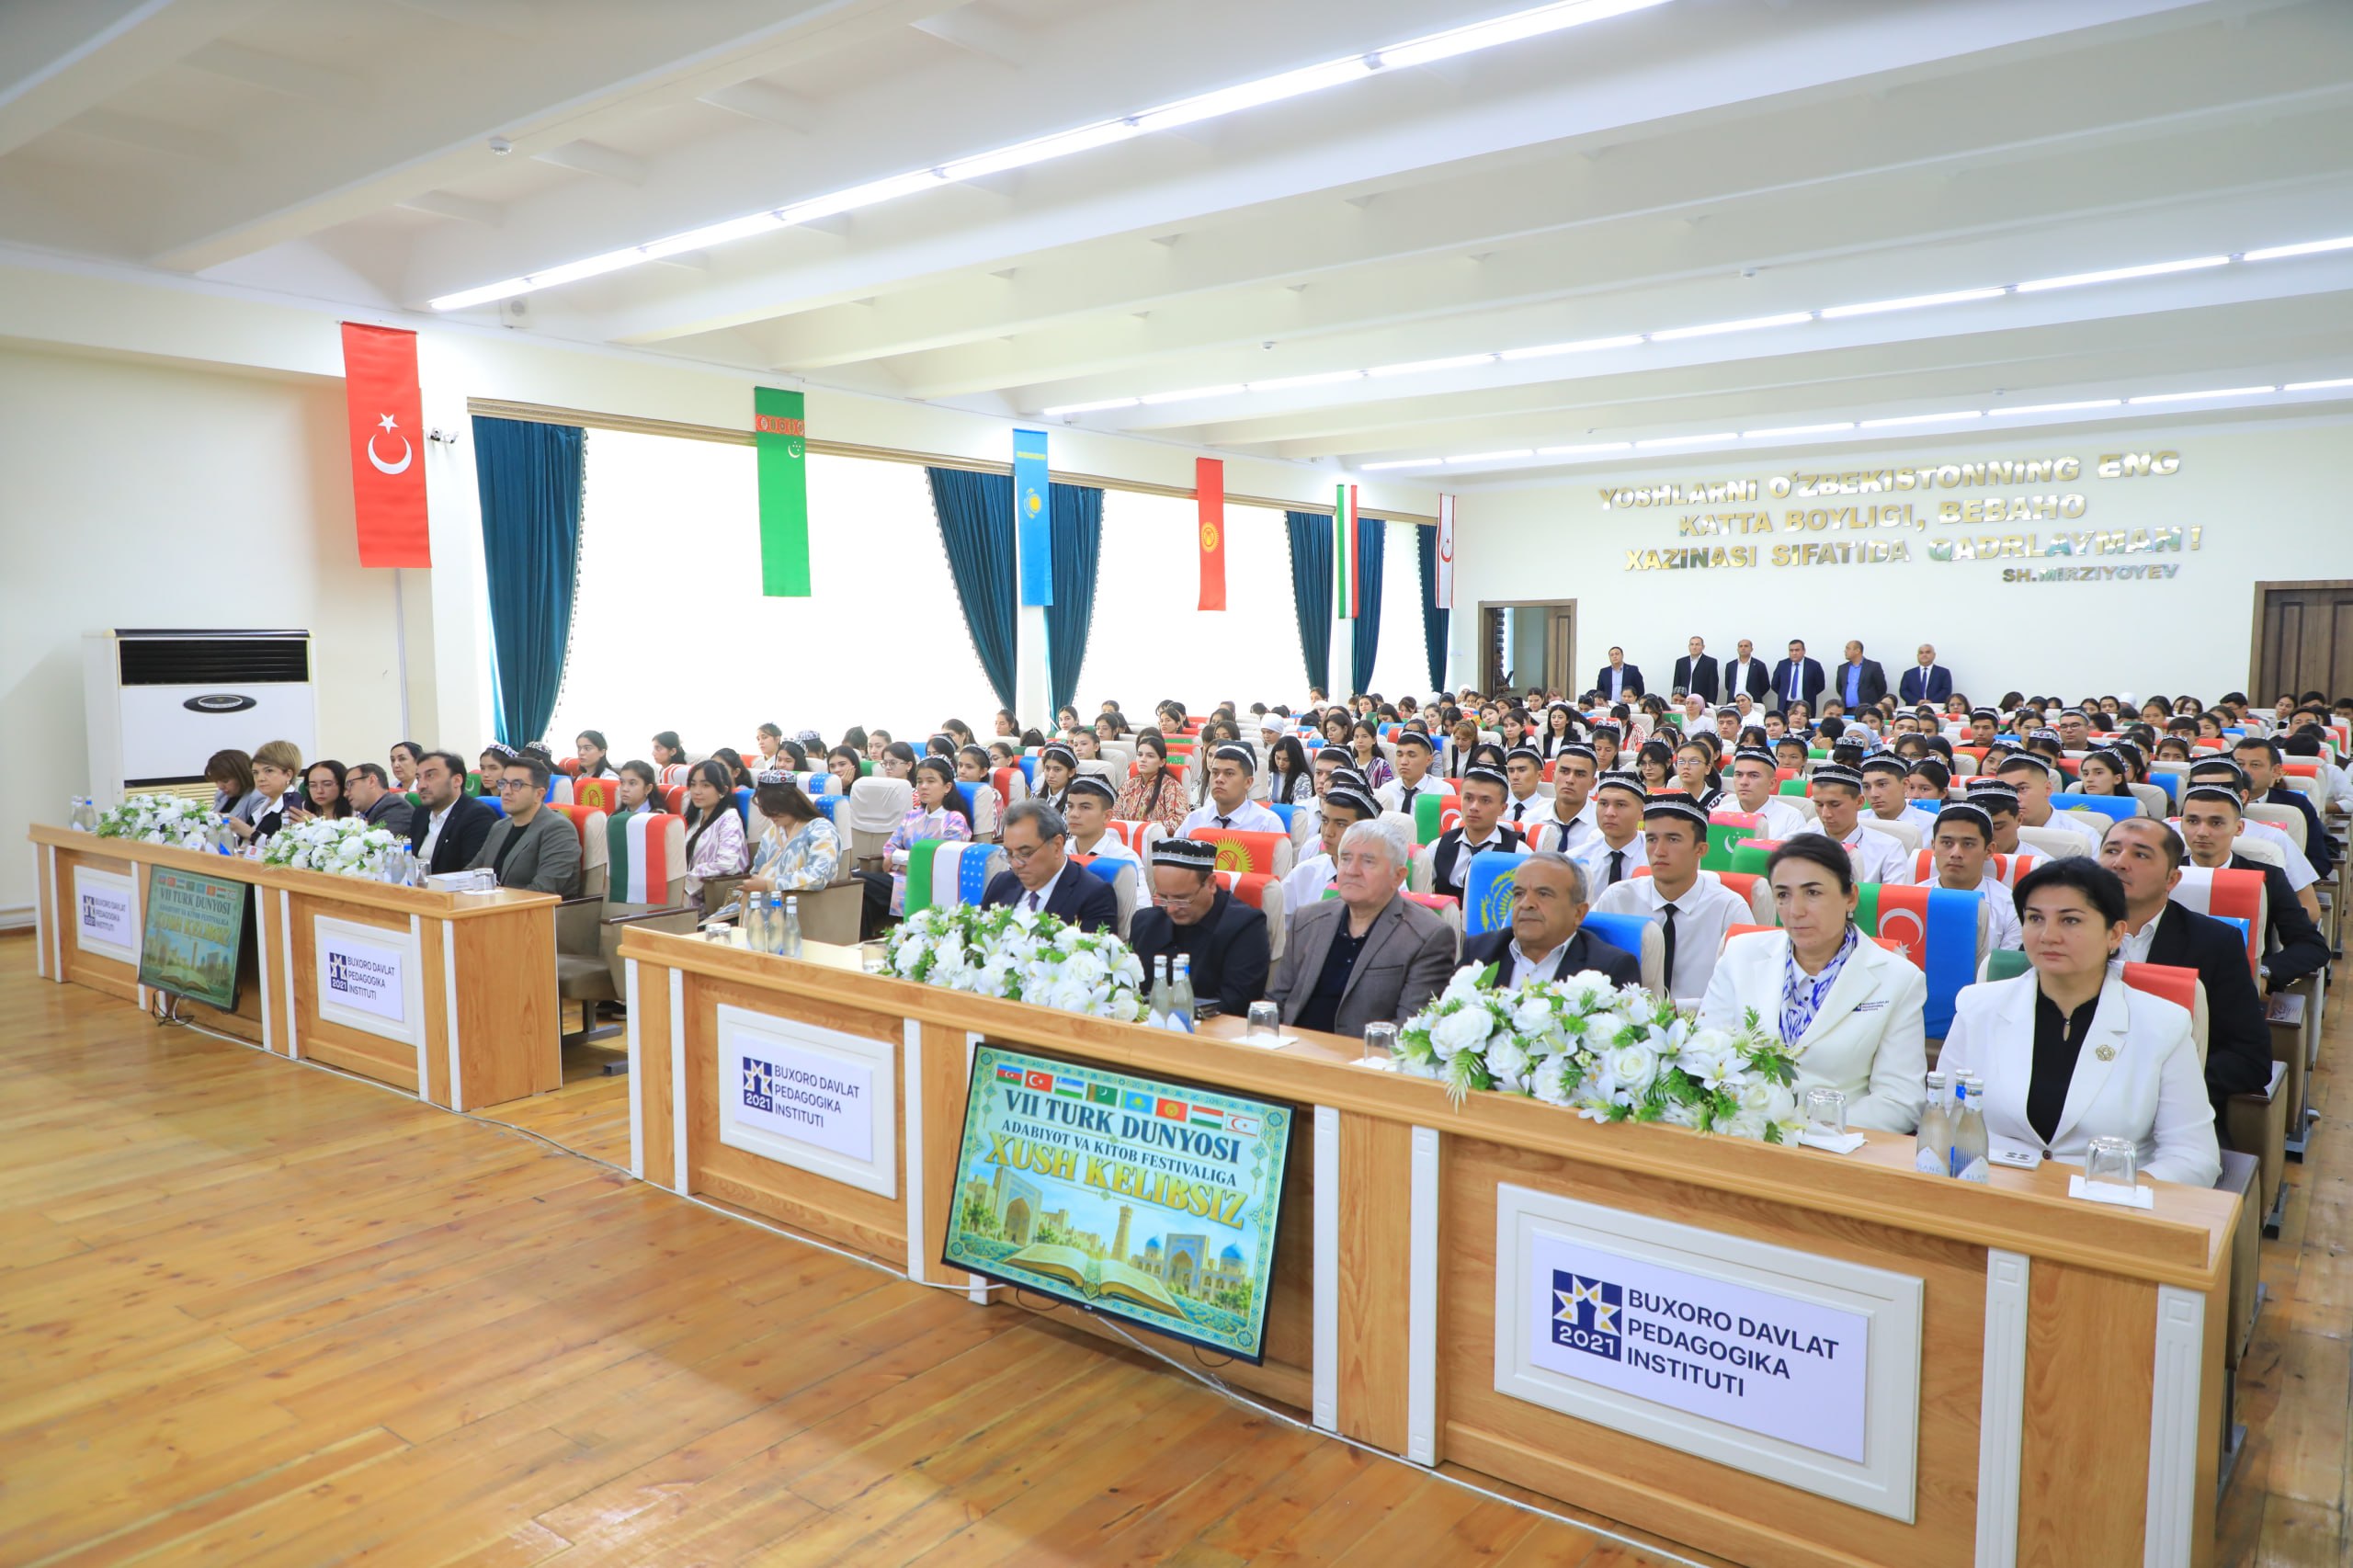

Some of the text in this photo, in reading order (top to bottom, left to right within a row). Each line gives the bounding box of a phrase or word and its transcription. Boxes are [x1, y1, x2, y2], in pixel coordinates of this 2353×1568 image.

[1598, 478, 1758, 510] YOSHLARNI
[2097, 449, 2181, 479] ENG
[1678, 493, 2087, 538] KATTA BOYLIGI, BEBAHO
[1623, 544, 1757, 571] XAZINASI
[1770, 539, 1913, 567] SIFATIDA
[173, 891, 194, 907] TURK
[195, 895, 232, 916] DUNYOSI
[347, 957, 395, 977] BUXORO DAVLAT
[347, 970, 386, 988] PEDAGOGIKA
[332, 978, 347, 992] 2021
[348, 984, 377, 1000] INSTITUTI
[774, 1064, 860, 1099] BUXORO DAVLAT
[745, 1092, 771, 1110] 2021
[774, 1084, 842, 1114] PEDAGOGIKA
[775, 1103, 824, 1128] INSTITUTI
[1005, 1088, 1243, 1165] VII TURK DUNYOSI
[1001, 1119, 1237, 1187] ADABIYOT VA KITOB FESTIVALIGA
[984, 1131, 1249, 1231] XUSH KELIBSIZ
[1559, 1324, 1616, 1357] 2021
[1628, 1288, 1839, 1360] BUXORO DAVLAT
[1628, 1318, 1791, 1380] PEDAGOGIKA
[1628, 1346, 1745, 1398] INSTITUTI
